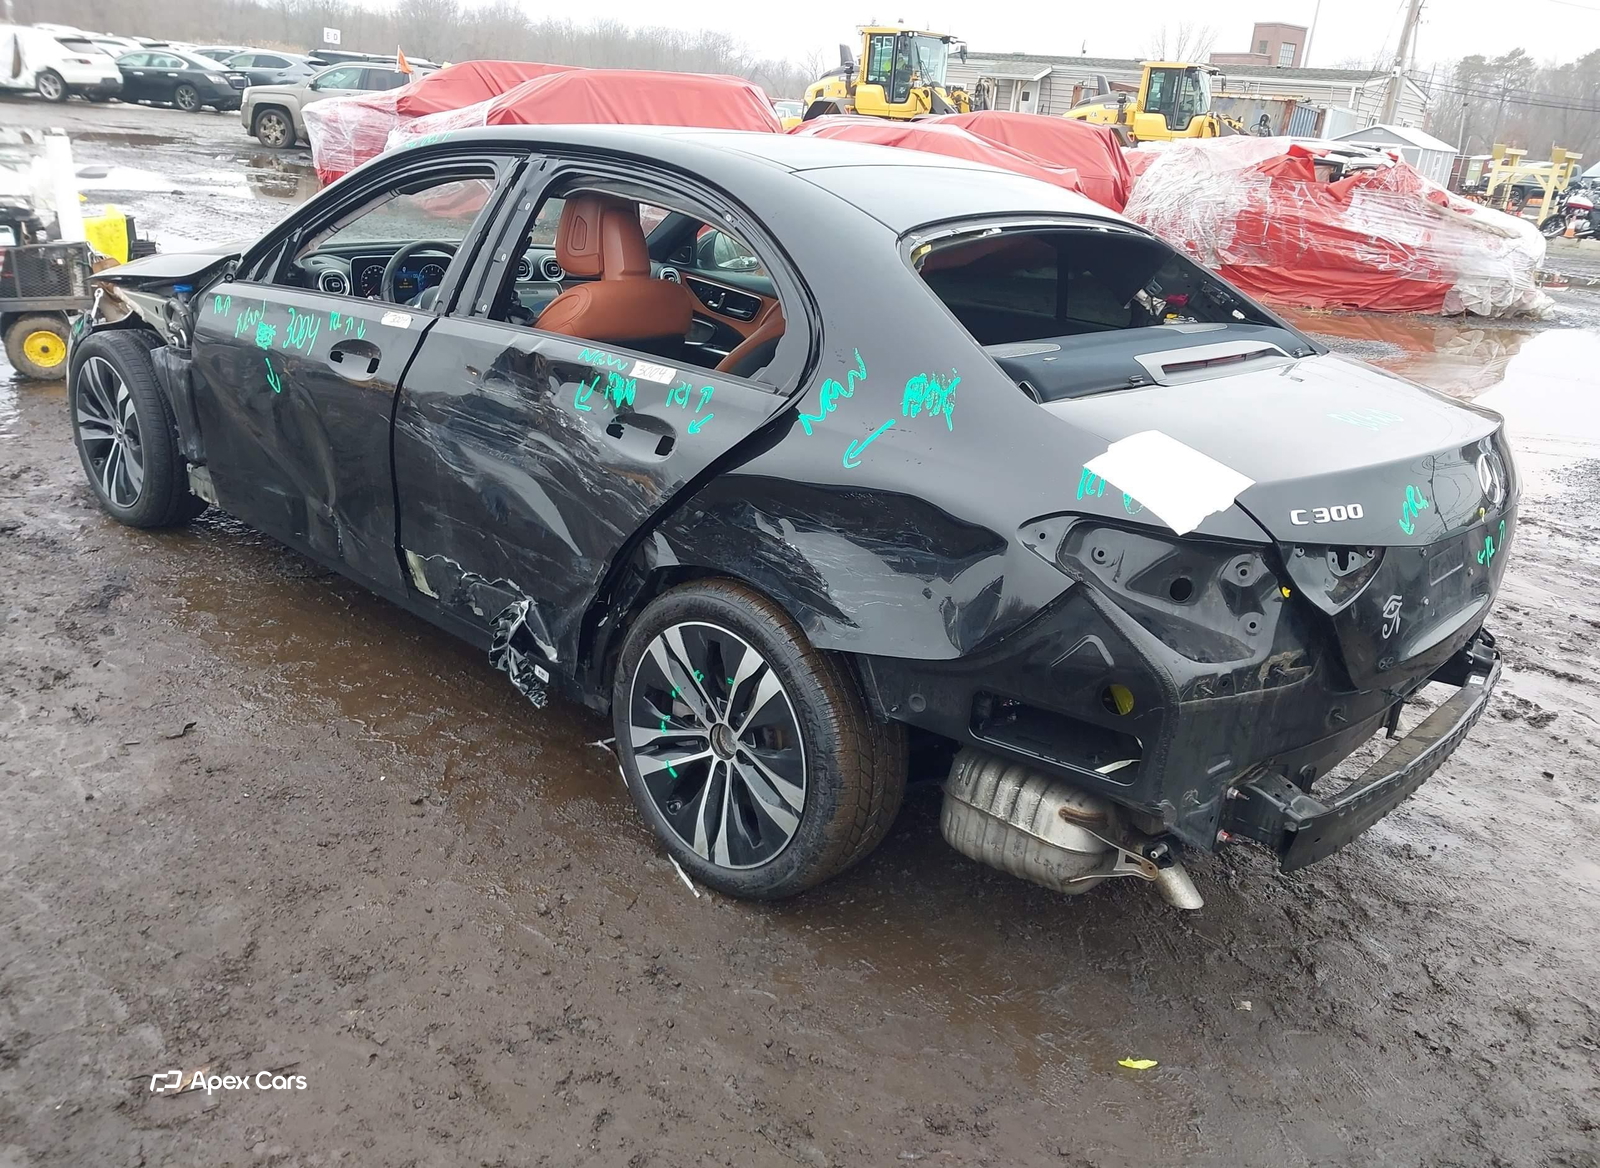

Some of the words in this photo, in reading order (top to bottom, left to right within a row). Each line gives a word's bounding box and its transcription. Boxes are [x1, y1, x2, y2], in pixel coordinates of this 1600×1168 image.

[282, 307, 322, 356] 3004
[577, 347, 629, 371] NEW
[1289, 508, 1310, 526] C
[1311, 503, 1364, 524] 300
